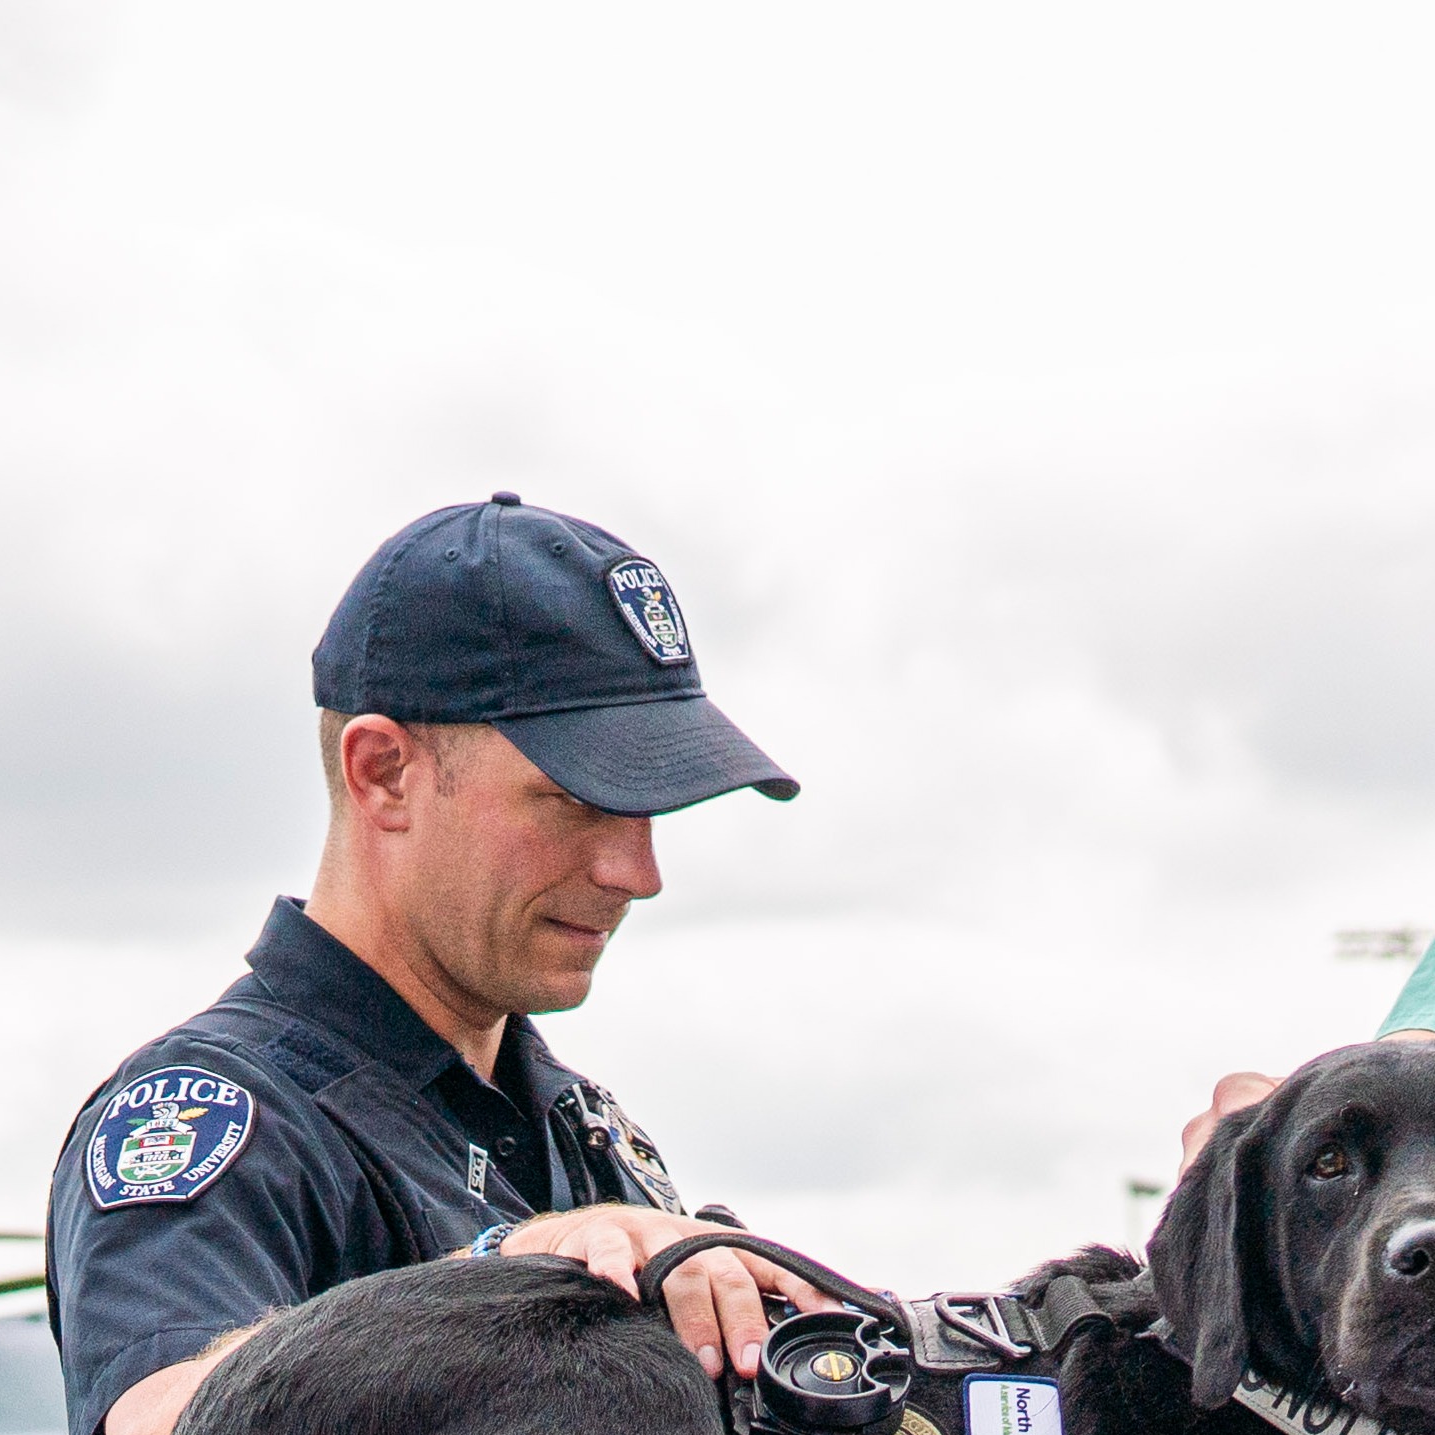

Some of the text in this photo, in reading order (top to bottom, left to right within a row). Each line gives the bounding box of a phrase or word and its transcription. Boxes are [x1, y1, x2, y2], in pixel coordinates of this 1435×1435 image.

[613, 568, 663, 591] POLICE
[108, 1077, 240, 1120] POLICE
[92, 1121, 243, 1197] MICHIGAN STATE UNIVERSITY
[1016, 1388, 1032, 1433] North
